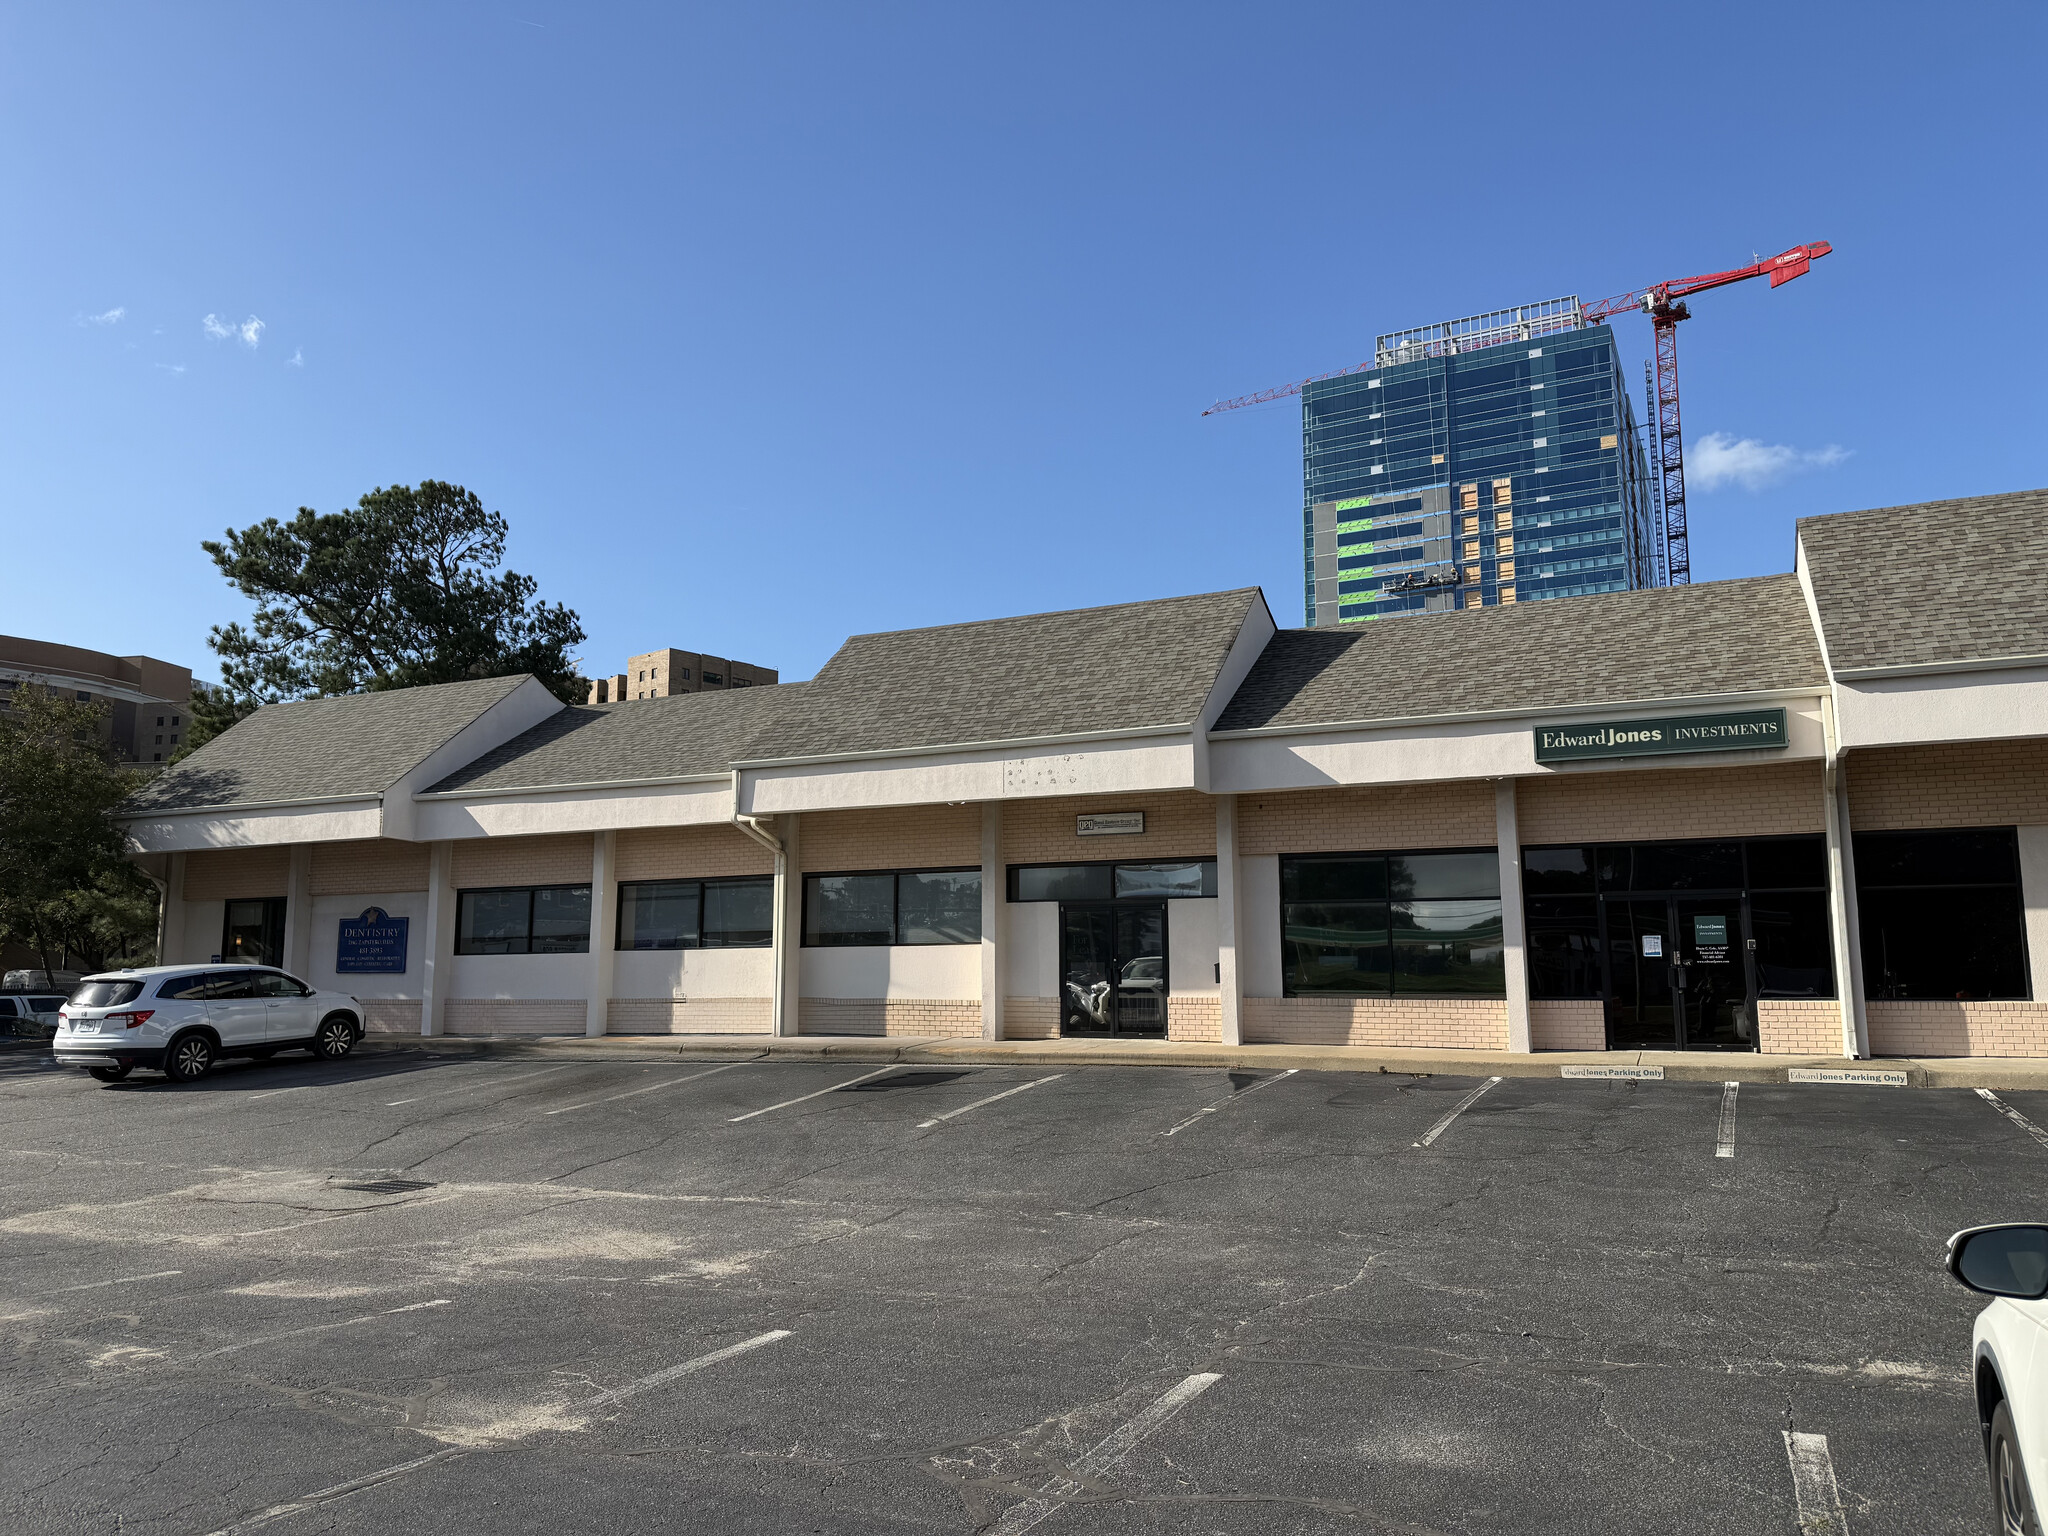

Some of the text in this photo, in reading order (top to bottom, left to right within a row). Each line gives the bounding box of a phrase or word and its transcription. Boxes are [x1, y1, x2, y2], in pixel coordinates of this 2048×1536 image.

[1542, 722, 1778, 749] Edward Jones INVESTMENTS
[344, 928, 400, 937] DENTISTRY
[1608, 1069, 1641, 1078] Parking
[1643, 1069, 1662, 1078] Only
[1790, 1071, 1906, 1084] Edward Jones Parking Only
